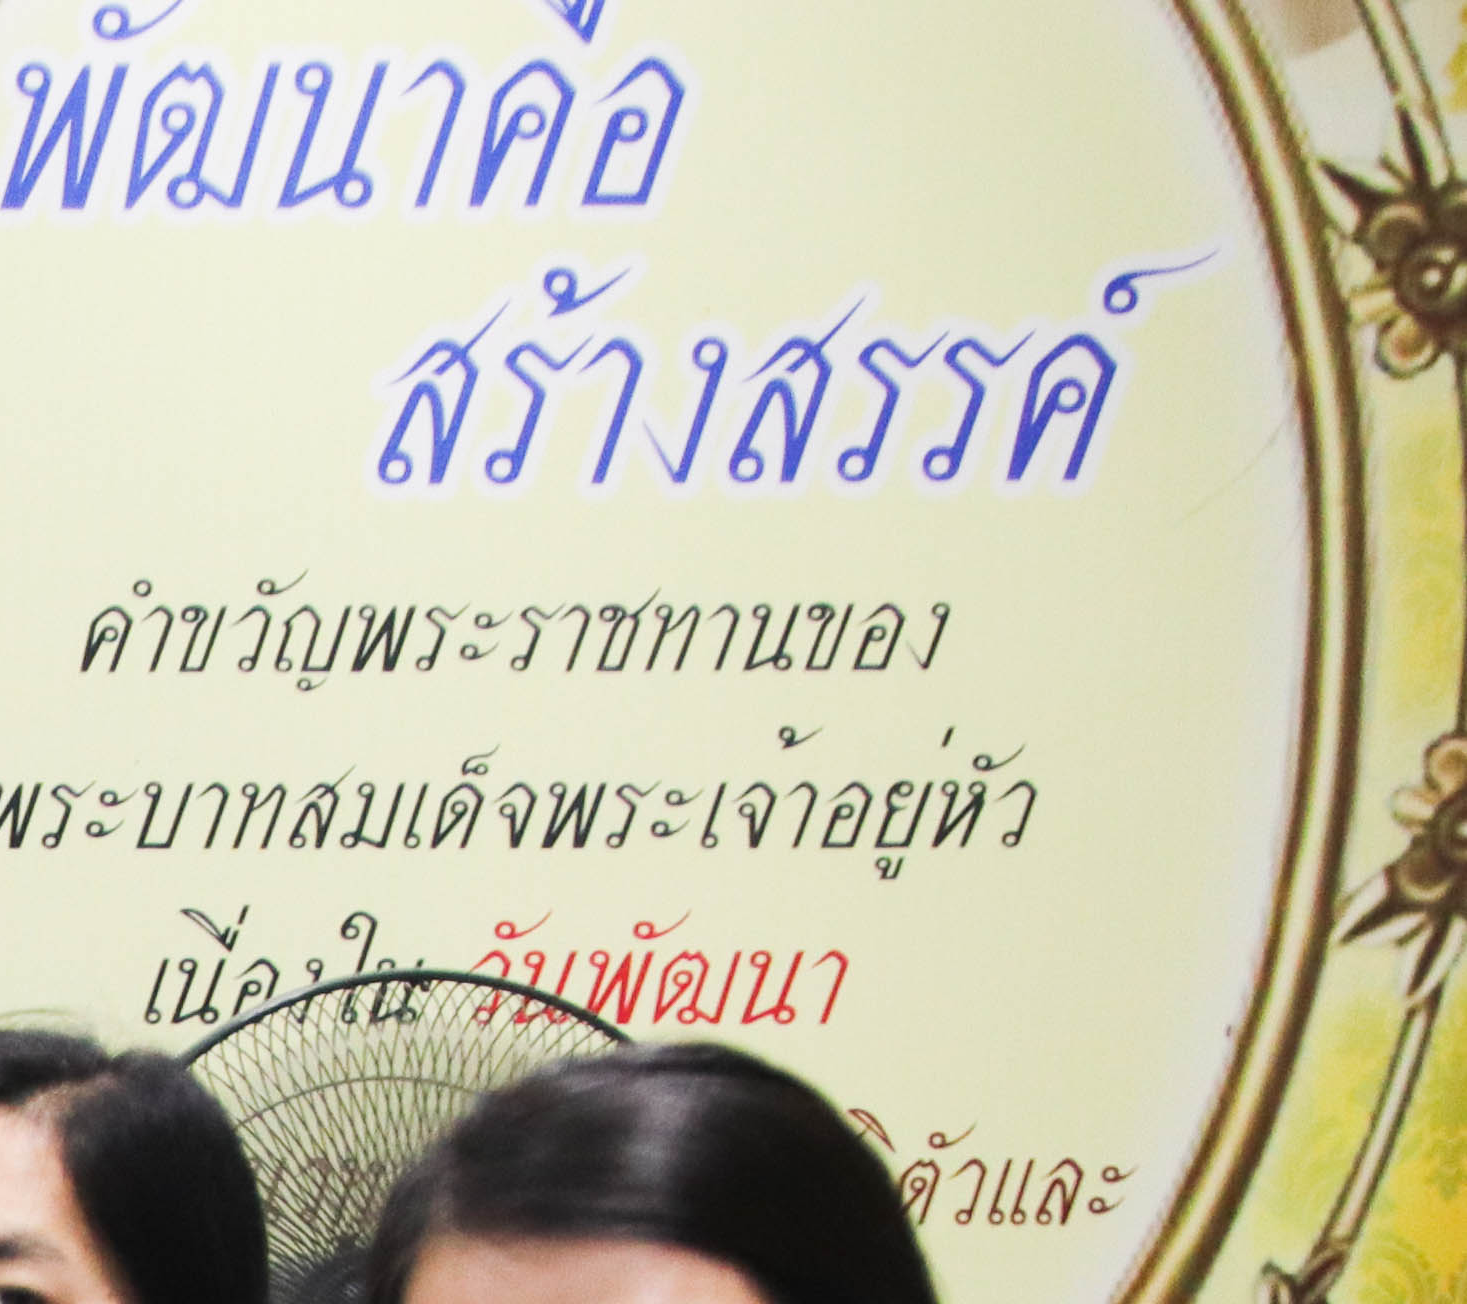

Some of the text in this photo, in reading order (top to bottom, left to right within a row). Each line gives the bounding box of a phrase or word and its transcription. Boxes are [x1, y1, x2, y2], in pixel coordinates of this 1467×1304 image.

[374, 250, 1219, 485] สร้างสรรค์
[80, 572, 951, 691] คำขวัญพระราชทานของ
